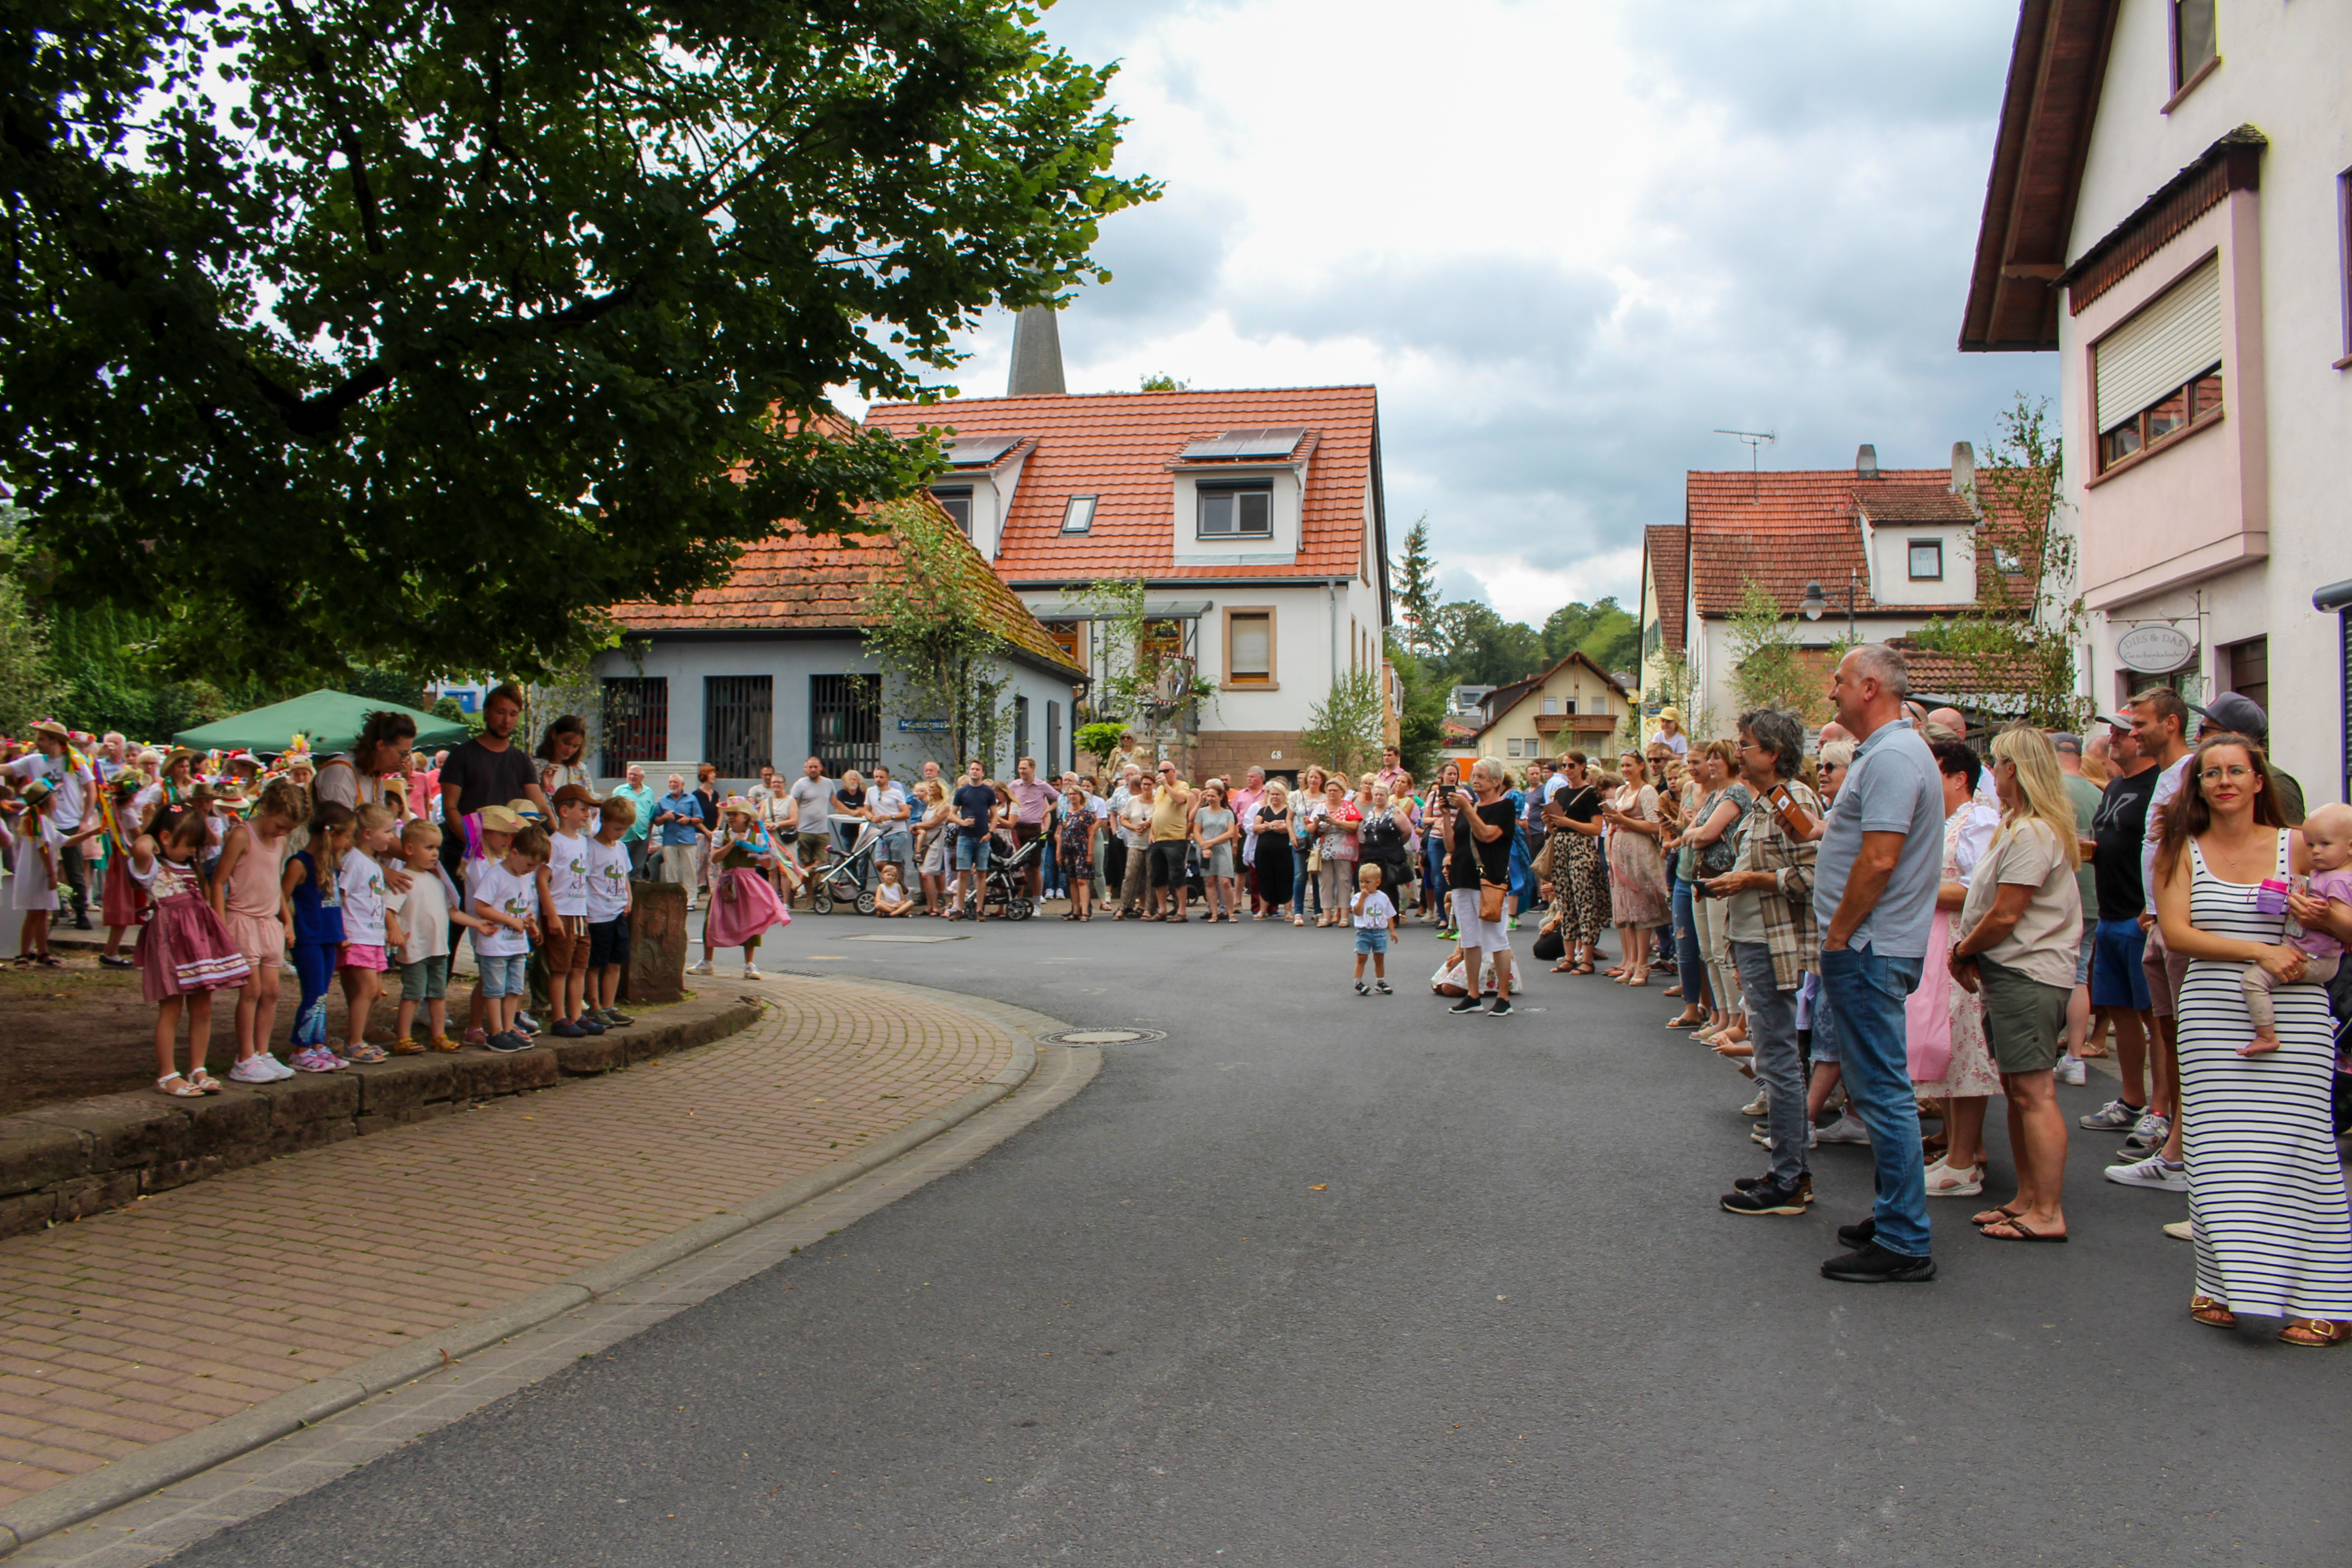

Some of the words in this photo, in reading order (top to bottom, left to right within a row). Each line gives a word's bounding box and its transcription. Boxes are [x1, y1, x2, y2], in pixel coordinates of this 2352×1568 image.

[2124, 634, 2147, 649] DIES
[2150, 633, 2159, 642] &
[2162, 634, 2185, 647] DAS
[2124, 651, 2185, 659] Geschenkeladen
[1271, 750, 1282, 760] 68
